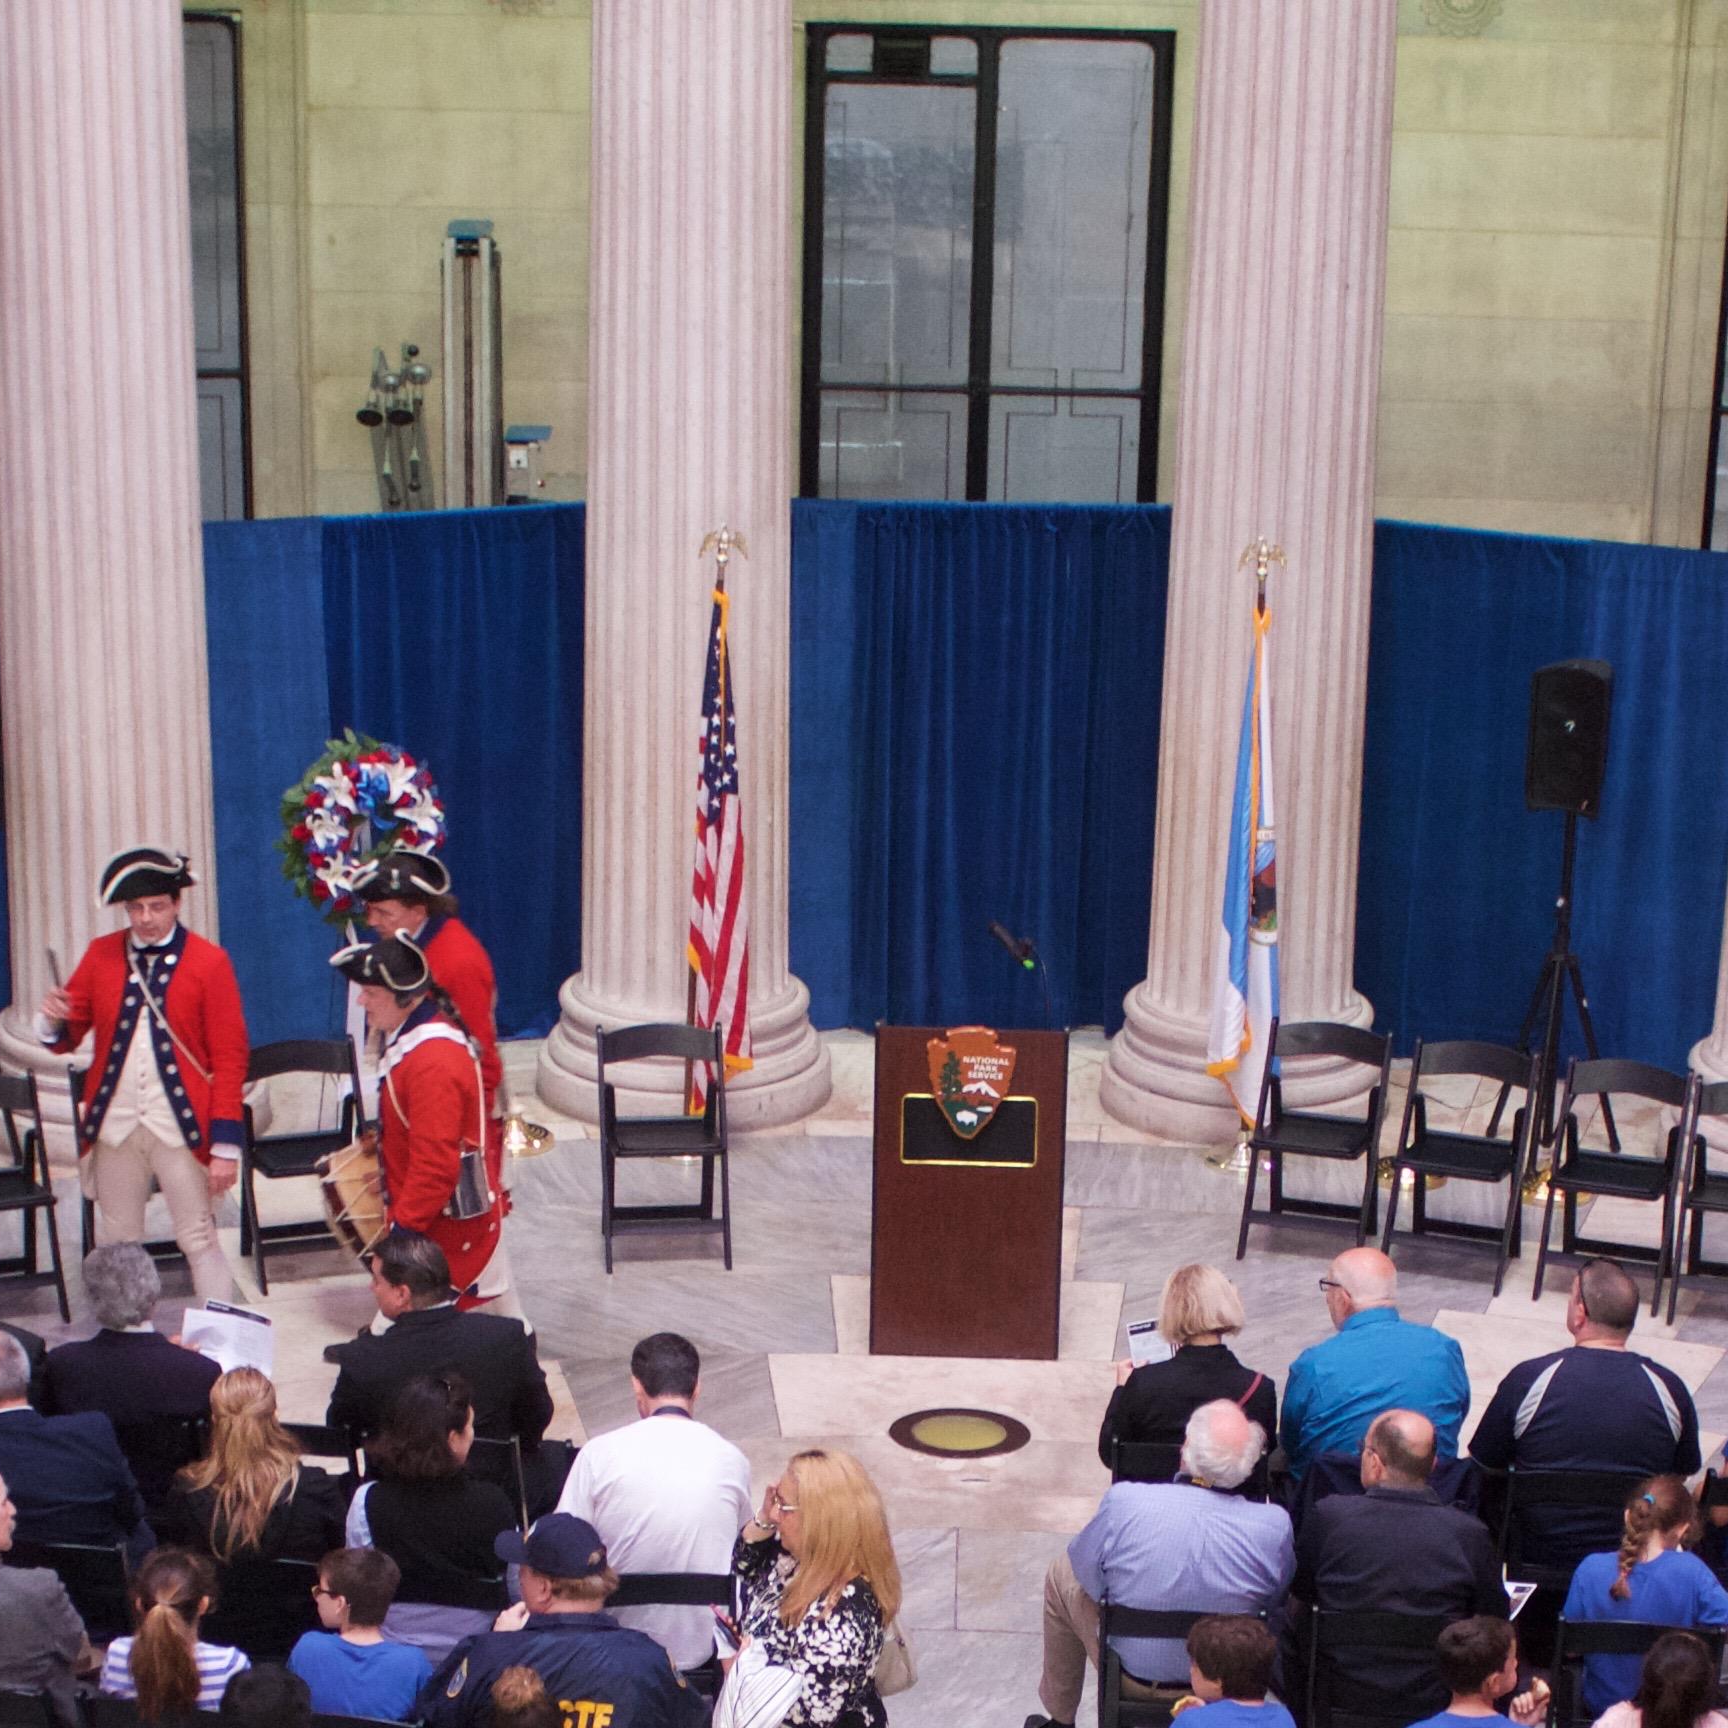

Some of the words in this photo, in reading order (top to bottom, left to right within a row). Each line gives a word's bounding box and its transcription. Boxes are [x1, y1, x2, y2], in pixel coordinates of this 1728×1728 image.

[963, 1056, 1009, 1066] NATIONAL
[974, 1064, 998, 1072] PARK
[968, 1071, 1004, 1080] SERVICE
